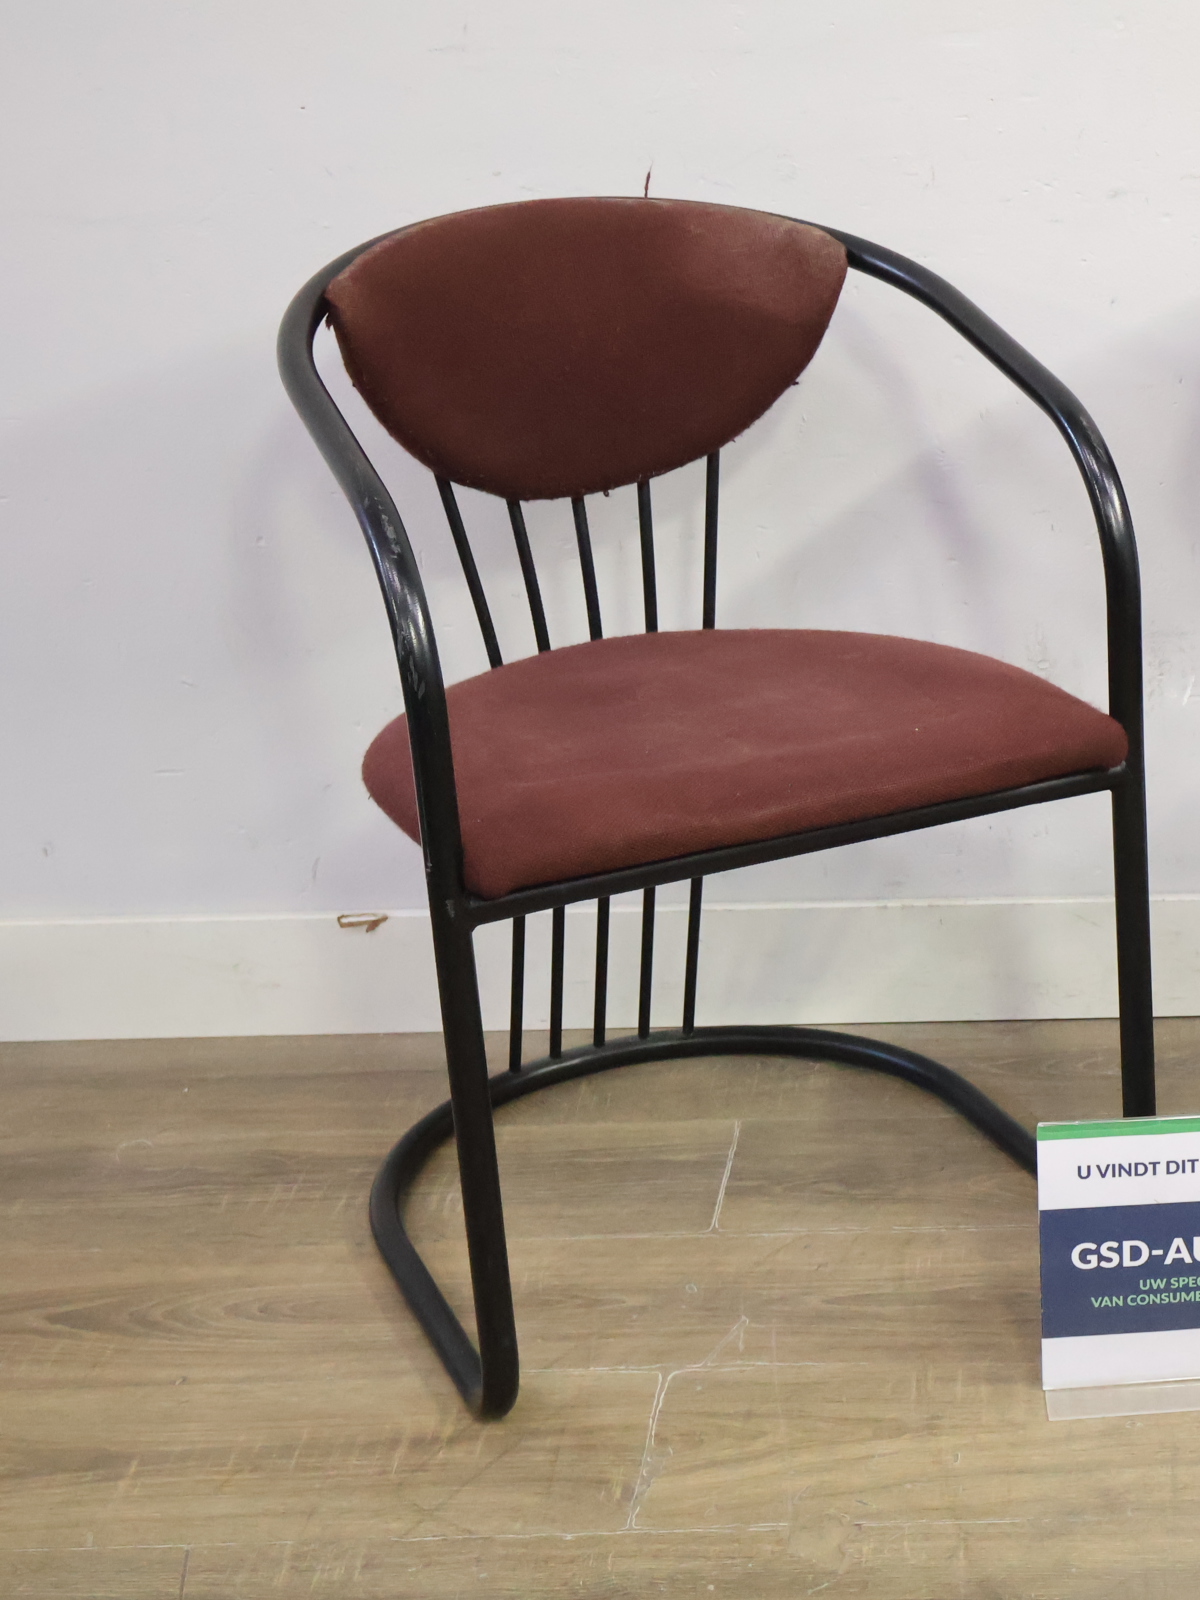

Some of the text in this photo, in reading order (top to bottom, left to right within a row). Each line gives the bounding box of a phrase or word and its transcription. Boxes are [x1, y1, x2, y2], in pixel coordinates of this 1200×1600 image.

[1077, 1165, 1091, 1180] U
[1096, 1161, 1161, 1179] VINDT
[1166, 1158, 1199, 1175] DIT
[1139, 1278, 1166, 1290] UW
[1091, 1295, 1124, 1308] VAN
